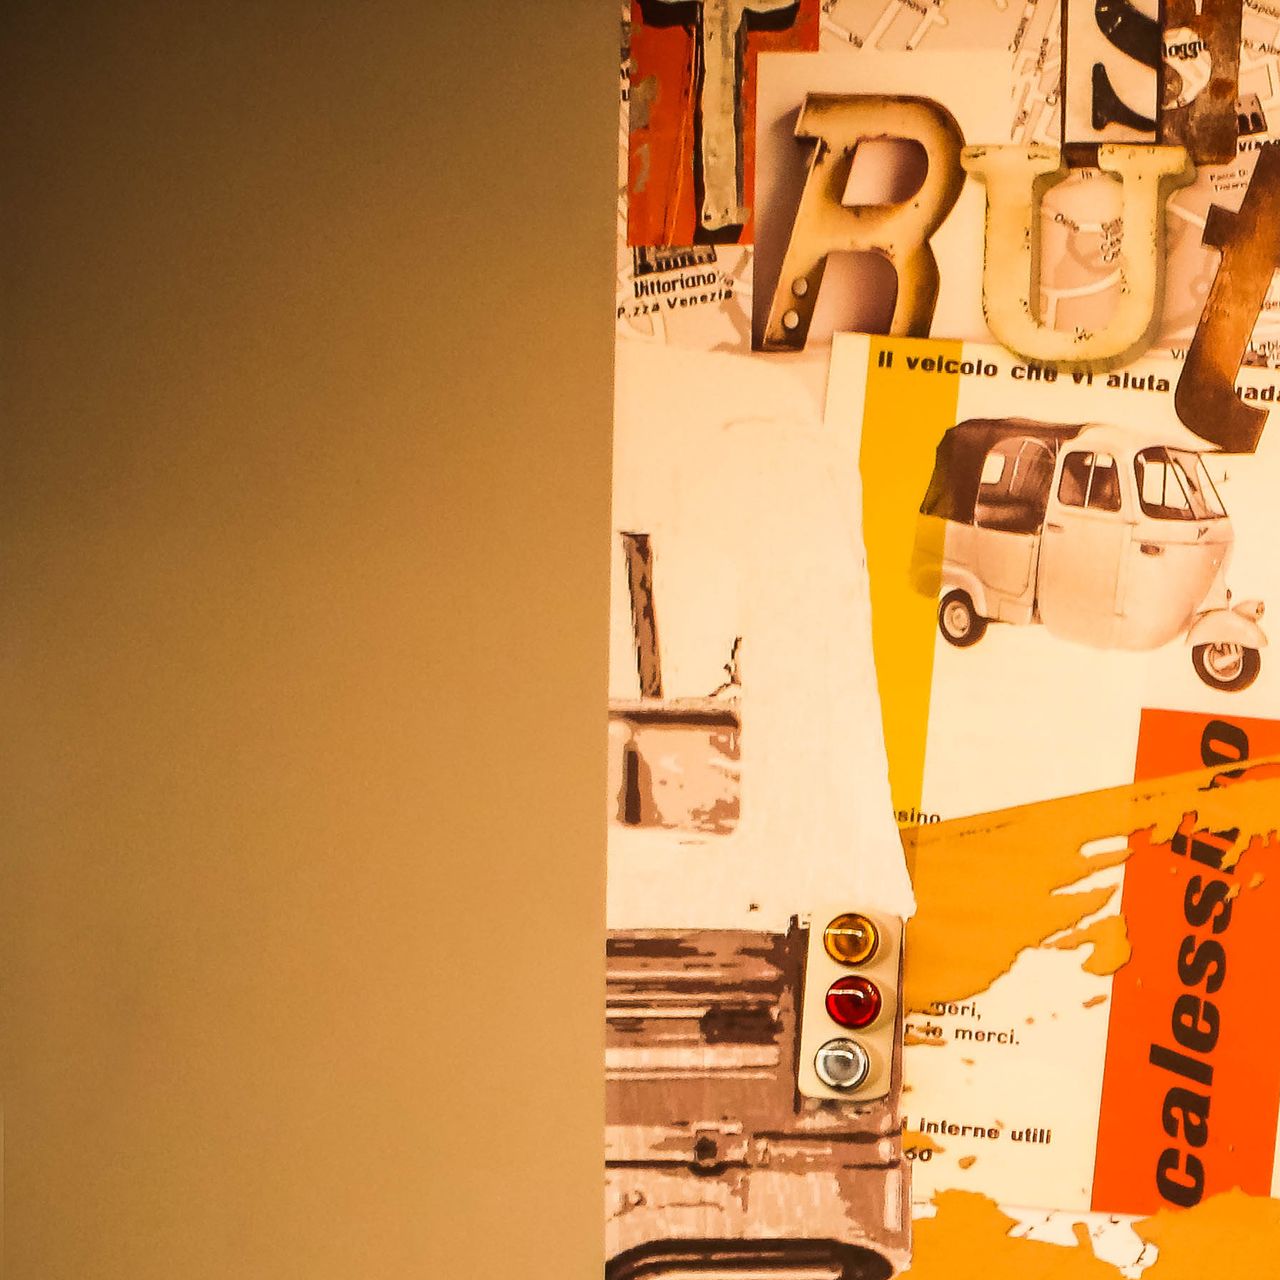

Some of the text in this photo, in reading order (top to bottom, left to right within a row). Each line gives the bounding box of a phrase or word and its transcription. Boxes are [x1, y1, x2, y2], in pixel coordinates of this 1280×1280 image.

[633, 271, 717, 298] Vittoriano
[667, 288, 733, 310] Venezia
[906, 355, 998, 377] veicolo
[1010, 363, 1059, 382] che
[1107, 372, 1170, 392] aiuta
[1149, 719, 1250, 1209] calessio
[954, 1028, 1020, 1045] merci.
[919, 1117, 1000, 1140] interne
[1010, 1127, 1052, 1144] utili
